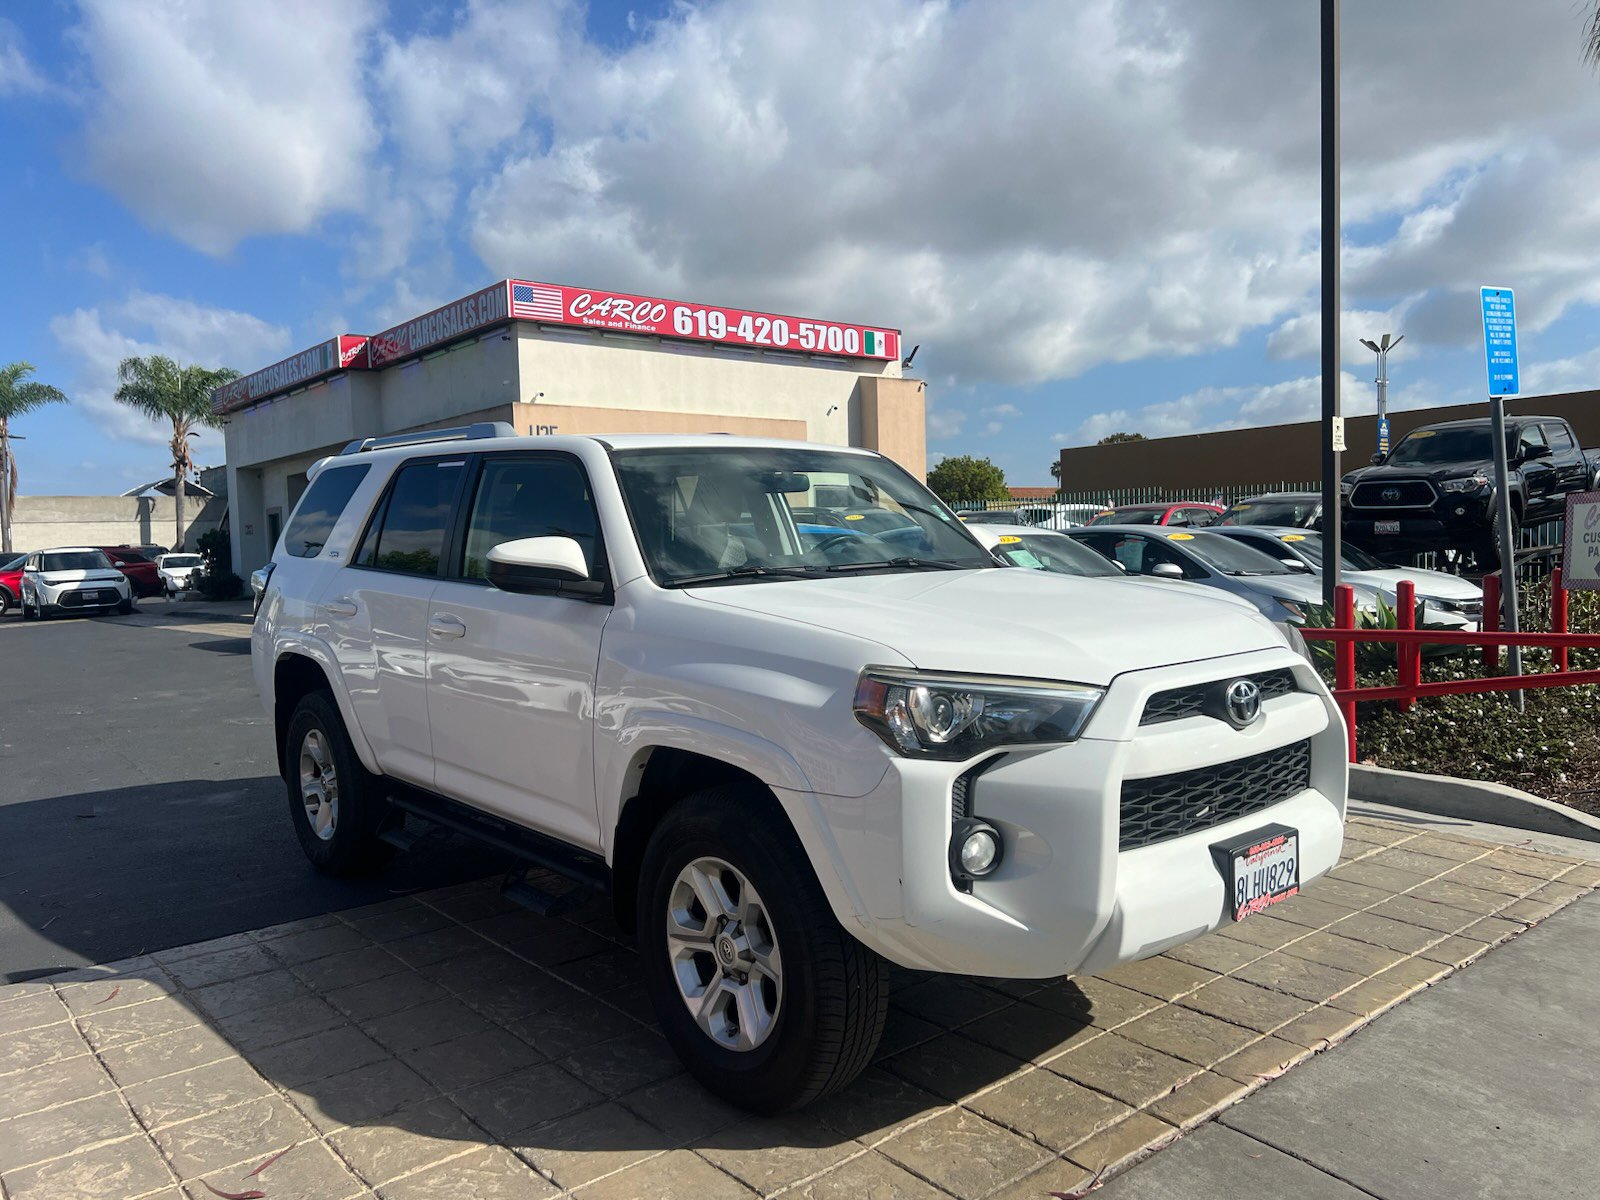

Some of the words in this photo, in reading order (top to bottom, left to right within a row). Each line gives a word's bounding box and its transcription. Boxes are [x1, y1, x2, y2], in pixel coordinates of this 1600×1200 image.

[408, 286, 507, 351] CARCOSALES.COM
[569, 293, 667, 324] CARCO
[582, 317, 606, 327] Sales
[607, 320, 623, 329] and
[624, 321, 657, 332] Finance
[673, 306, 860, 354] 619-420-5700
[248, 346, 321, 398] CARCOSALES.COM
[1244, 844, 1286, 867] California
[1236, 857, 1295, 907] 8LHU829
